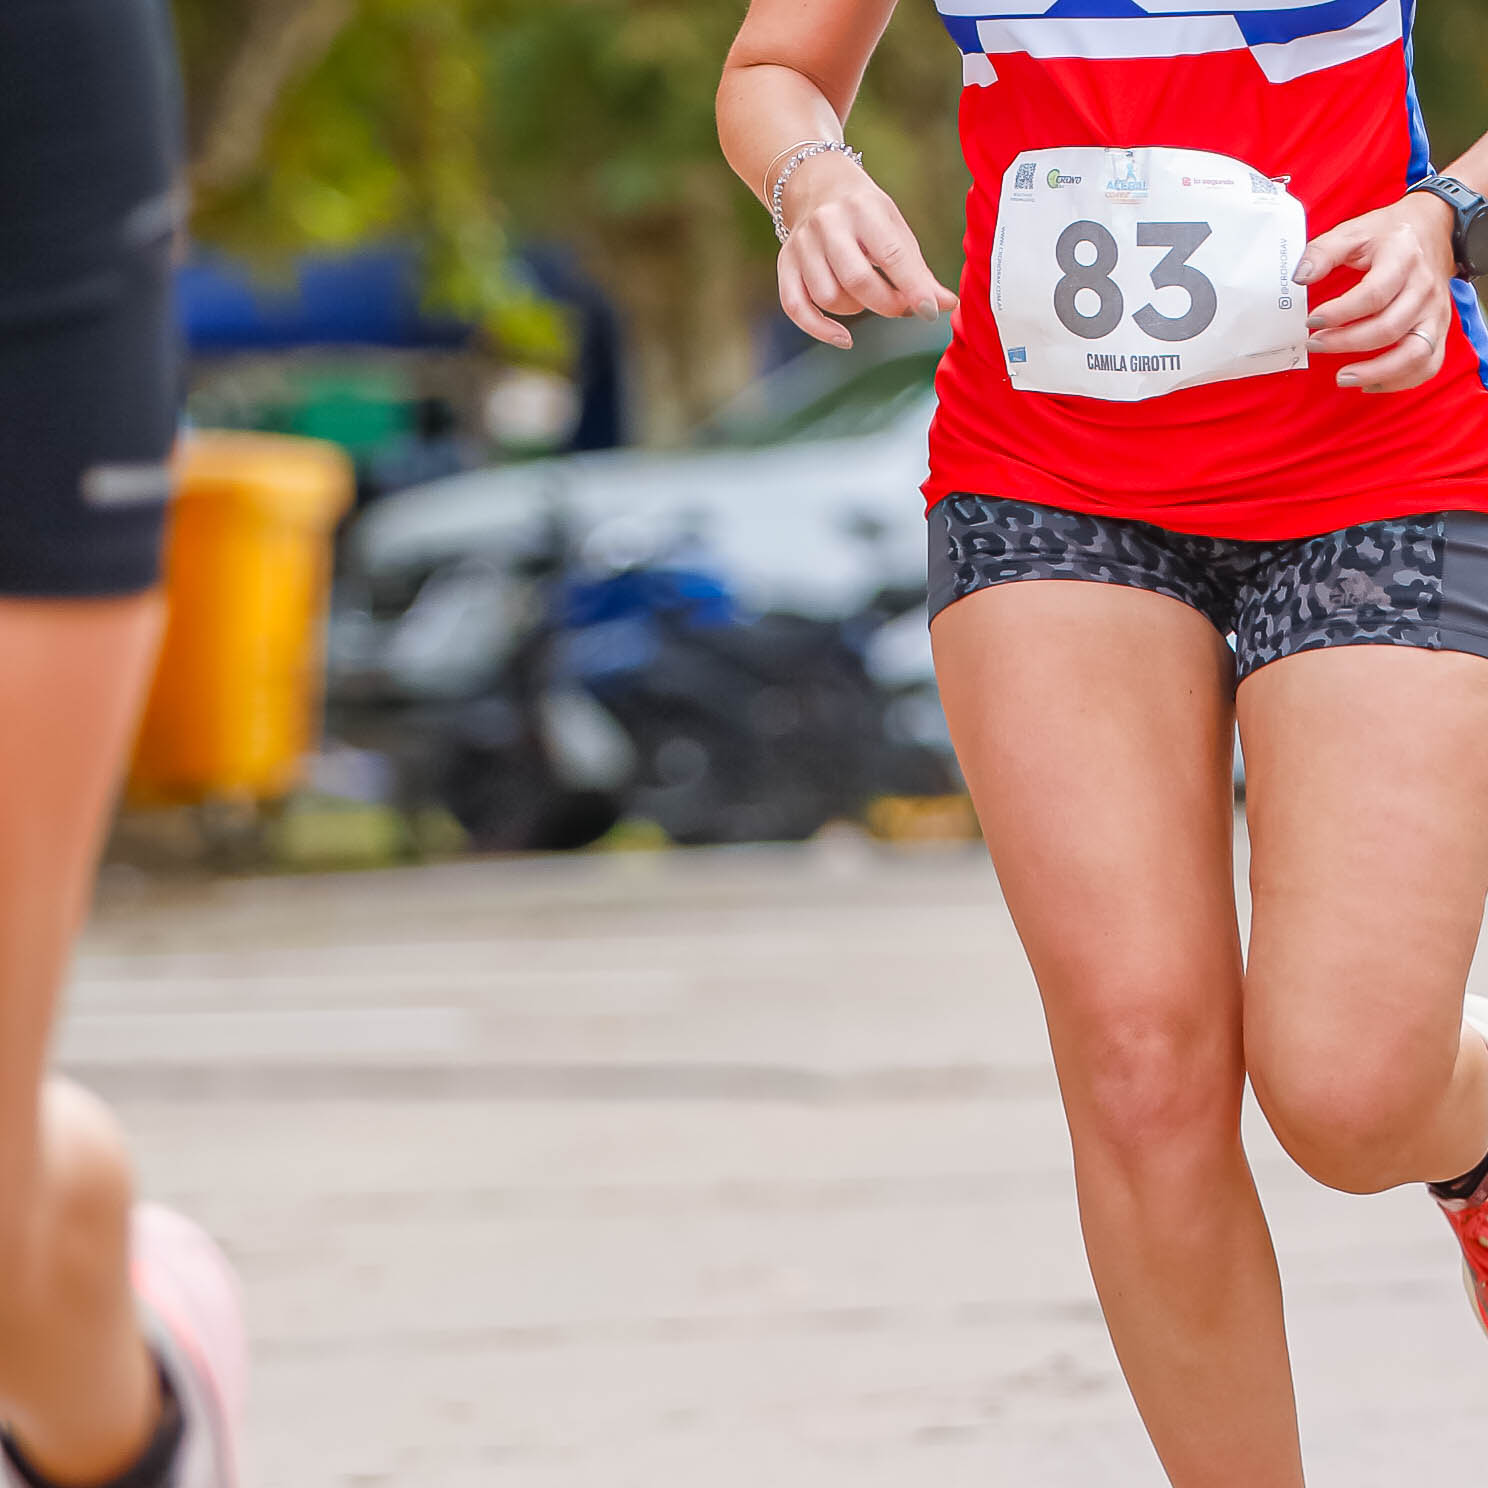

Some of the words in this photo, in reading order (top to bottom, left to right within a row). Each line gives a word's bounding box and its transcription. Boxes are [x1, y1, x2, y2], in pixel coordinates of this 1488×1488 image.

[1053, 220, 1218, 341] 83
[1086, 353, 1128, 372] CAMILA
[1129, 353, 1181, 372] GIROTTI
